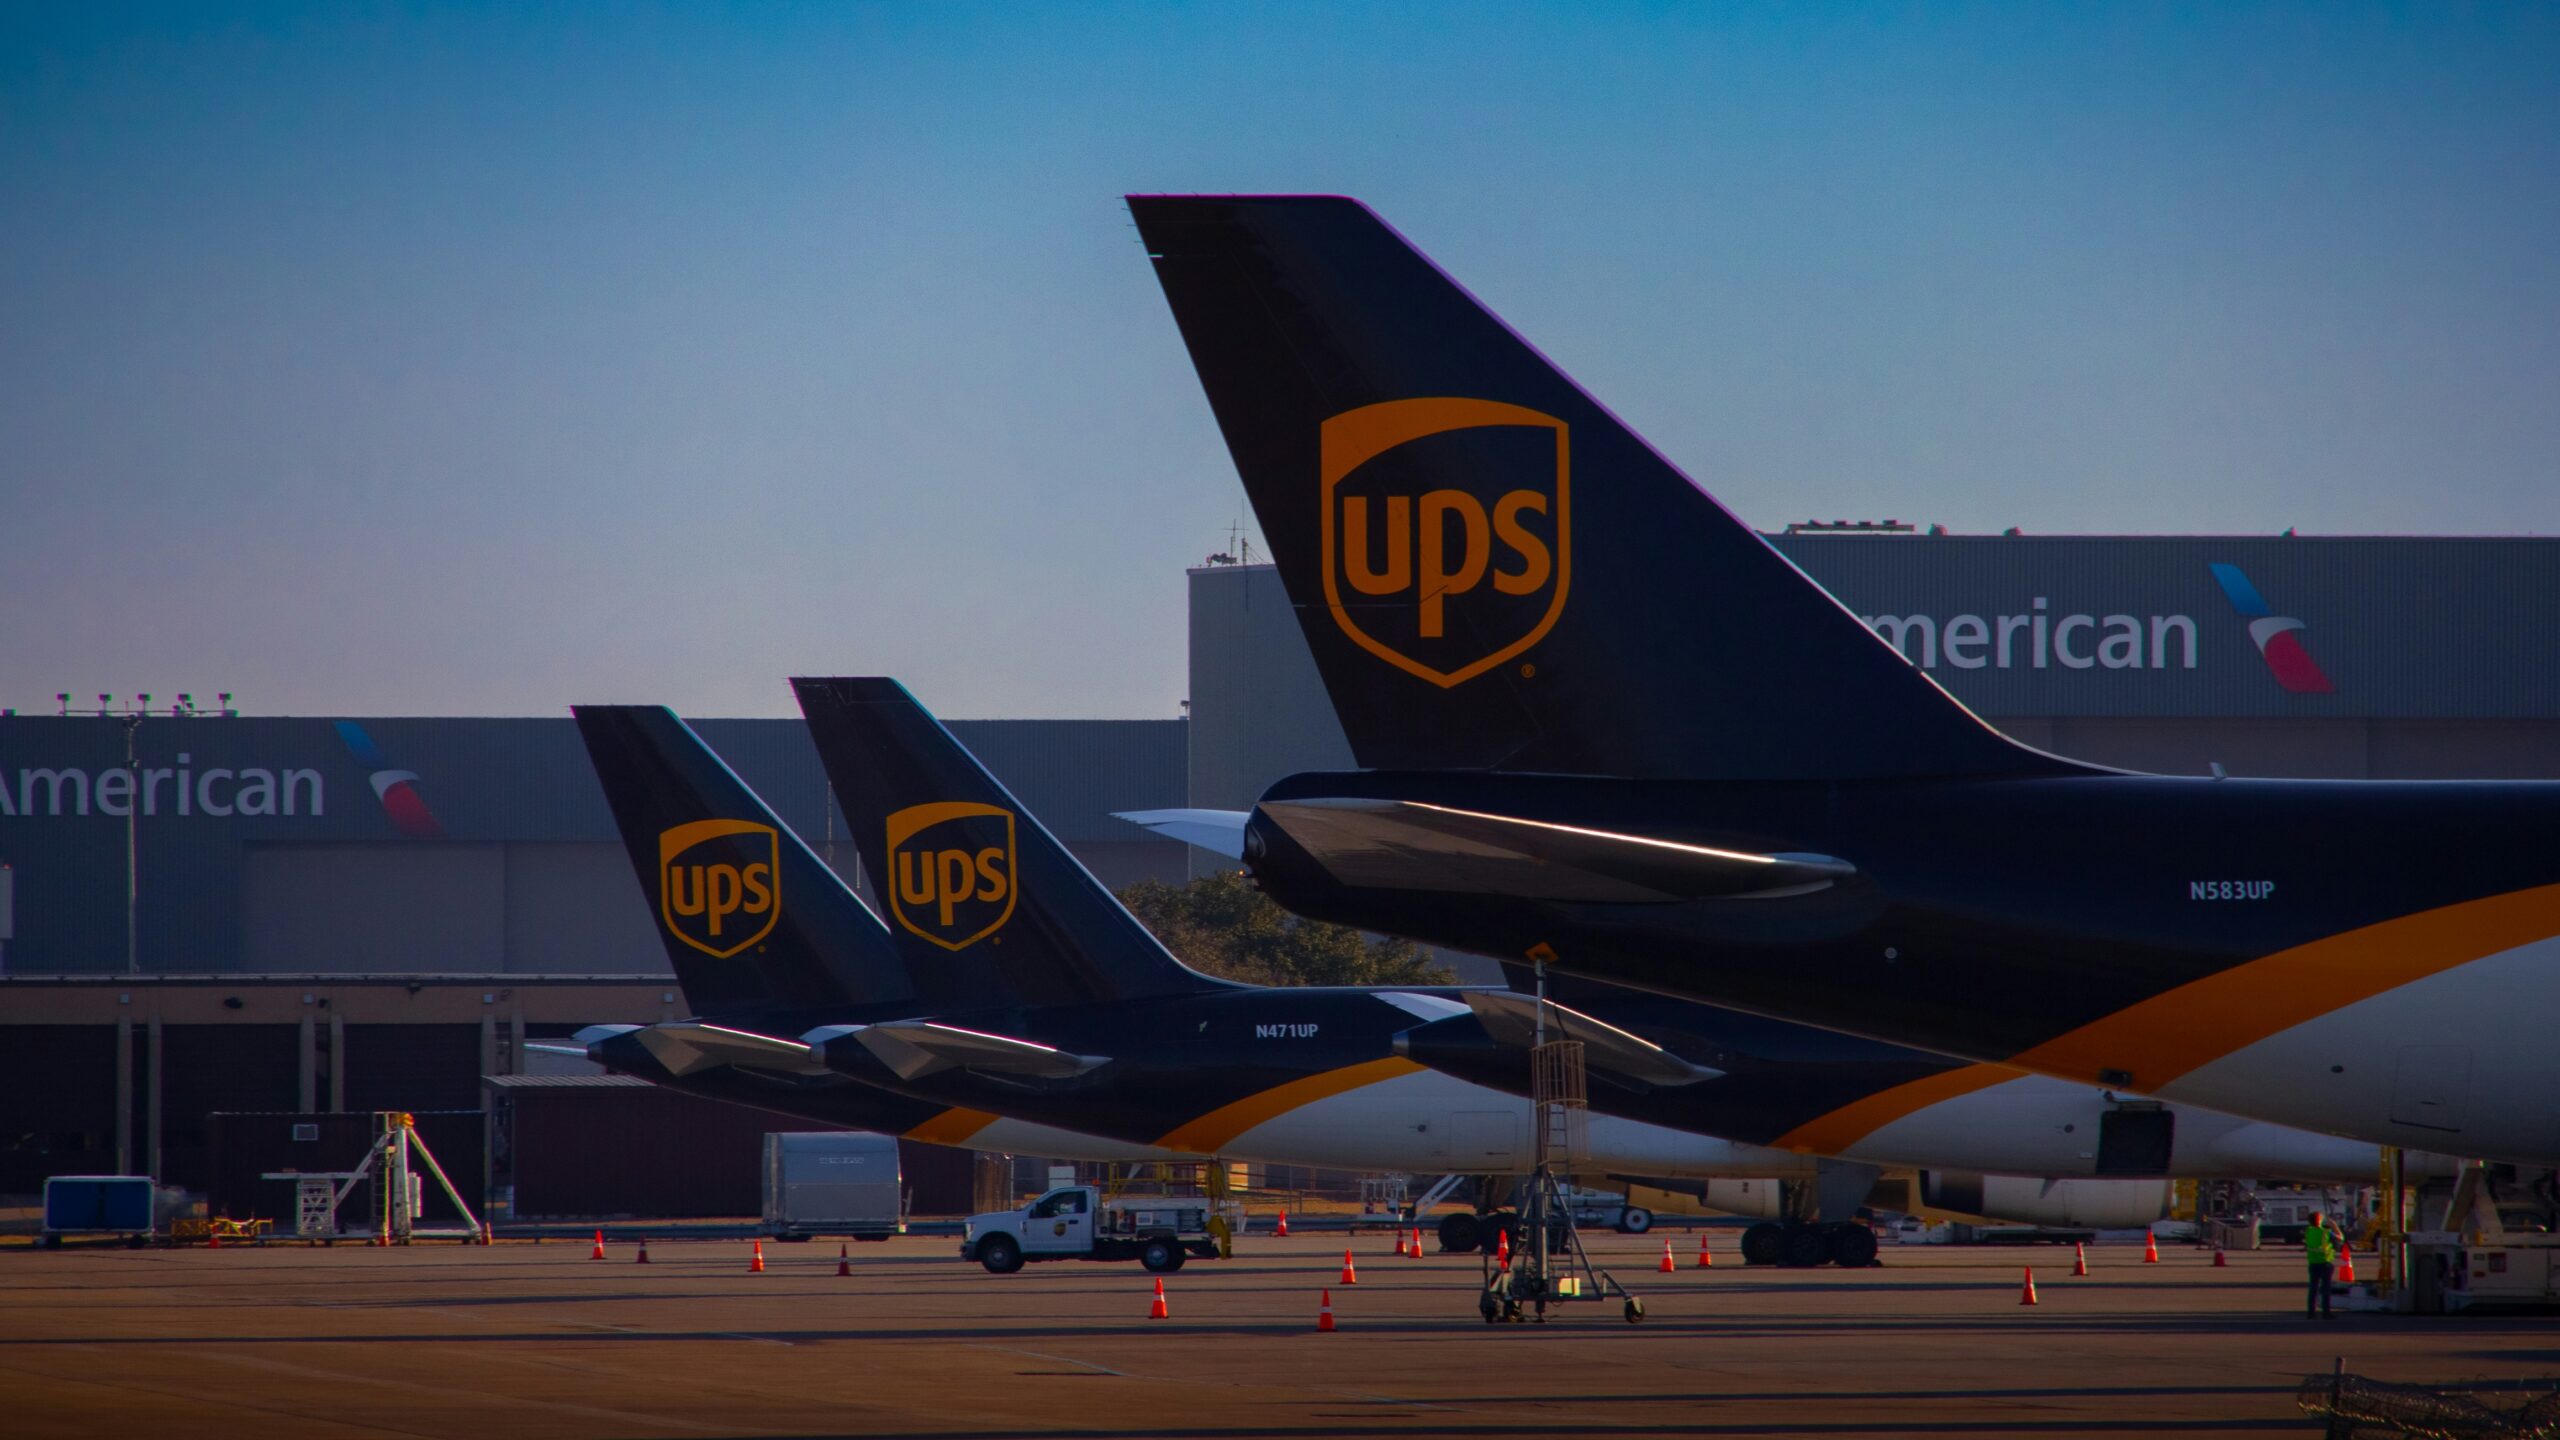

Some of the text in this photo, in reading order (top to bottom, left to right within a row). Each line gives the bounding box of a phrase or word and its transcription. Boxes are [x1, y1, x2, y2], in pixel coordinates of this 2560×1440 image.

[1343, 489, 1551, 638] ups
[1861, 597, 2197, 669] merican
[670, 862, 771, 936] ups
[898, 847, 1007, 926] ups
[2190, 881, 2275, 900] N583UP
[1256, 1024, 1319, 1039] N471UP
